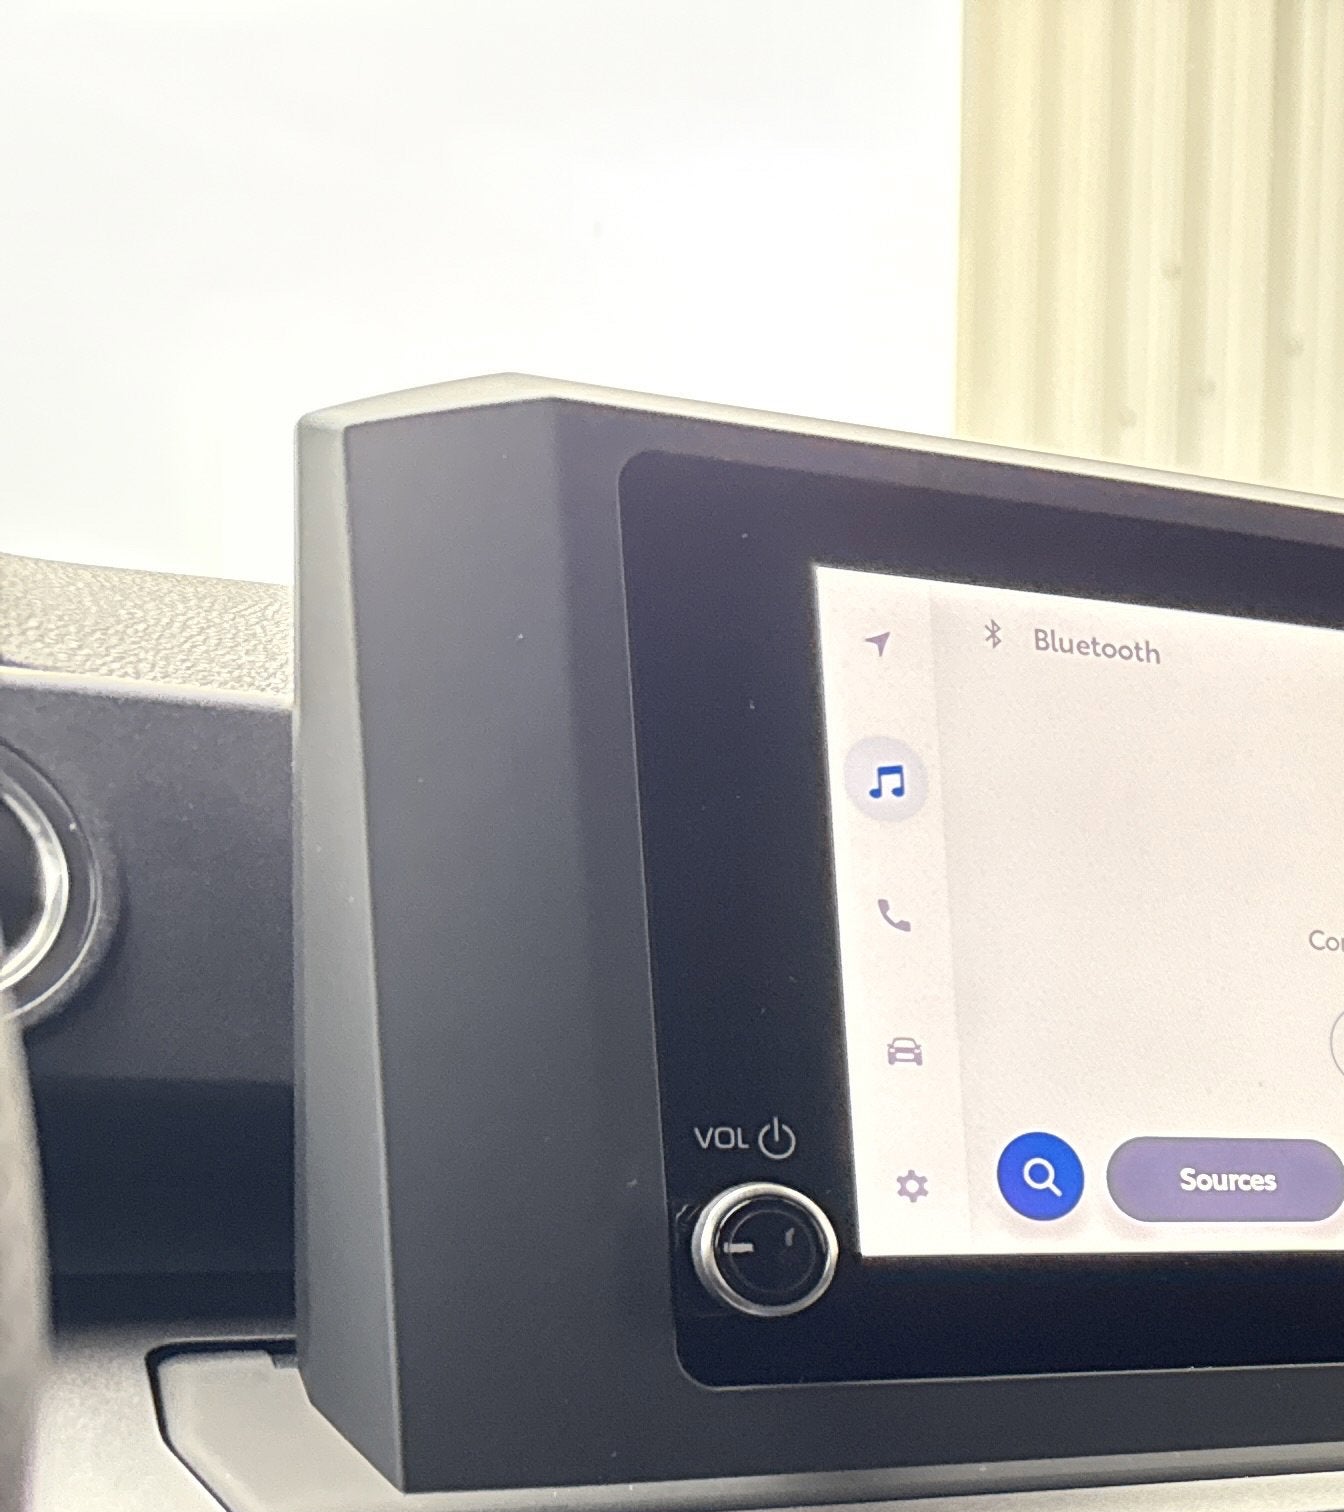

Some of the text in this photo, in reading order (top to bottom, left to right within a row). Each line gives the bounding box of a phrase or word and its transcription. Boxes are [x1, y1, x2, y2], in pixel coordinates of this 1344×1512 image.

[1034, 628, 1161, 664] Bluetooth
[693, 1127, 750, 1149] VOL
[1179, 1167, 1278, 1192] Sources
